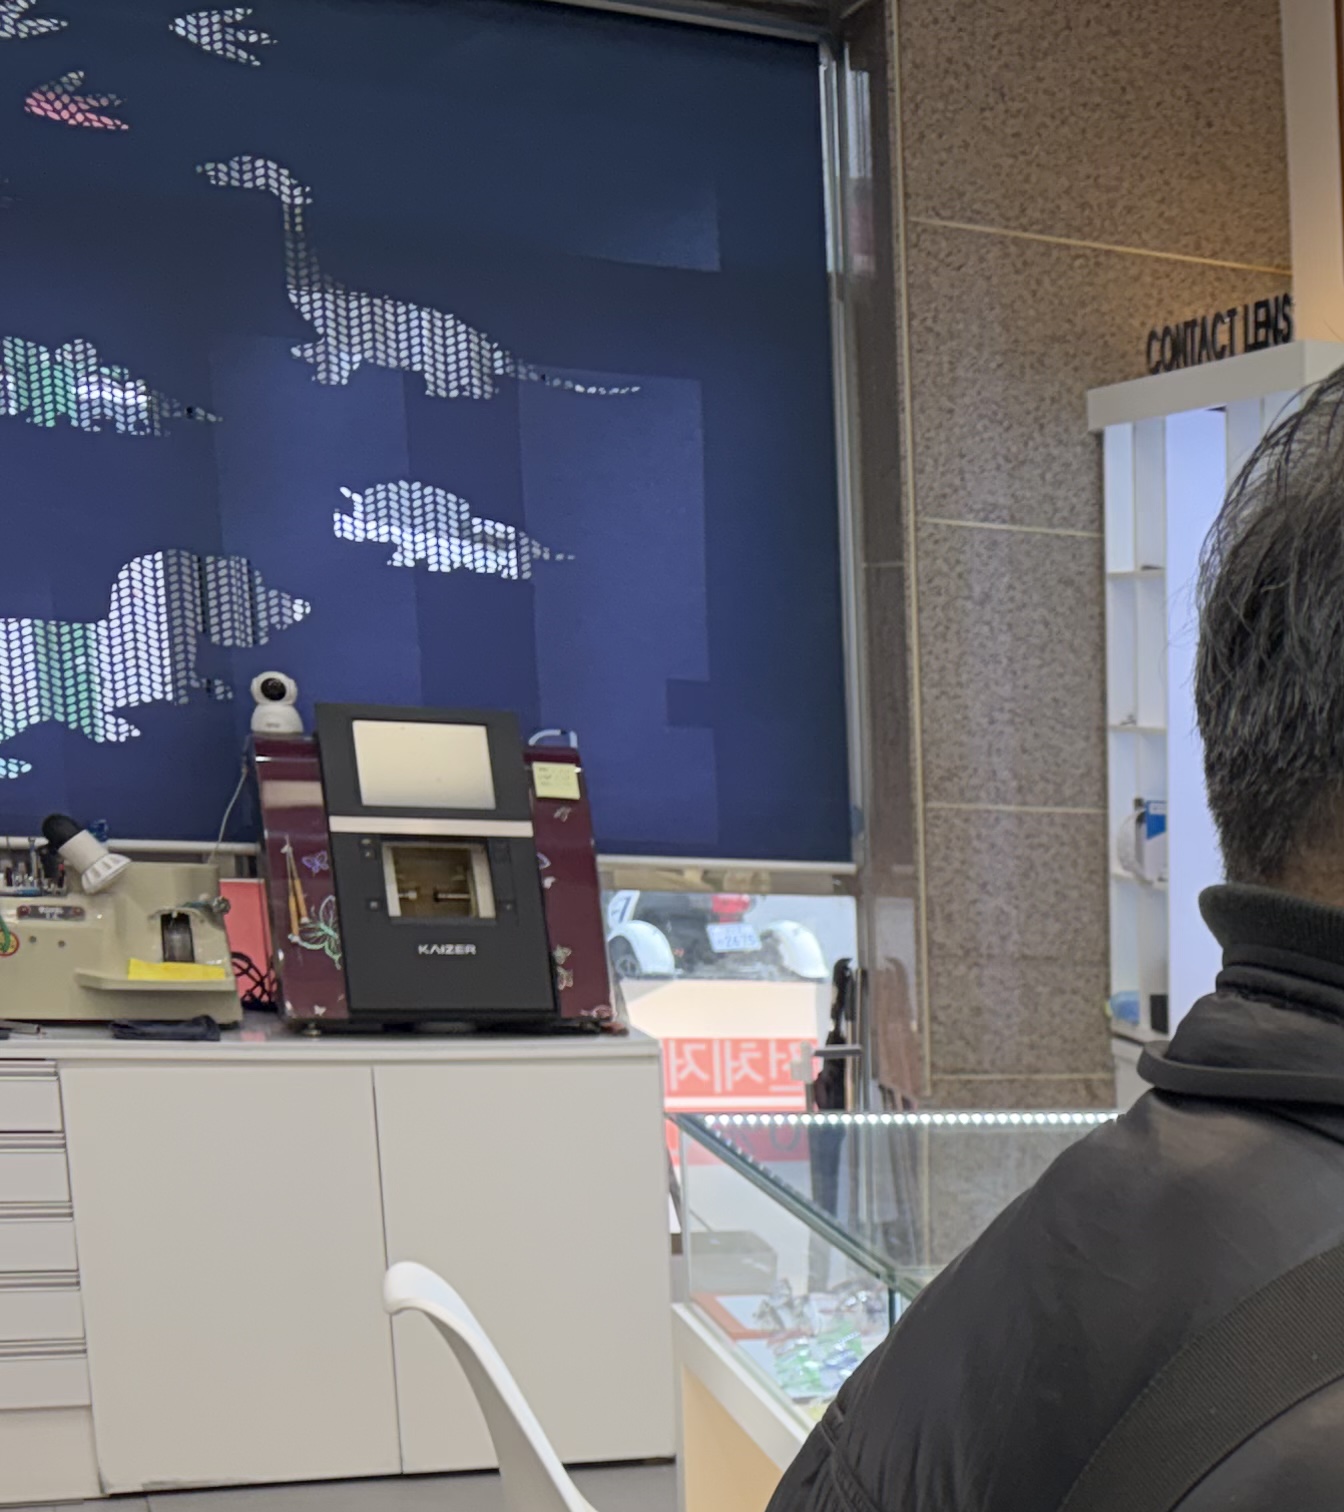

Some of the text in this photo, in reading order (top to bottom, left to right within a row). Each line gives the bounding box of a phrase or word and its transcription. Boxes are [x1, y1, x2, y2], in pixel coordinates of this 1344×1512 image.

[1146, 291, 1294, 375] CONTACT LENS
[417, 943, 477, 955] KAIZER
